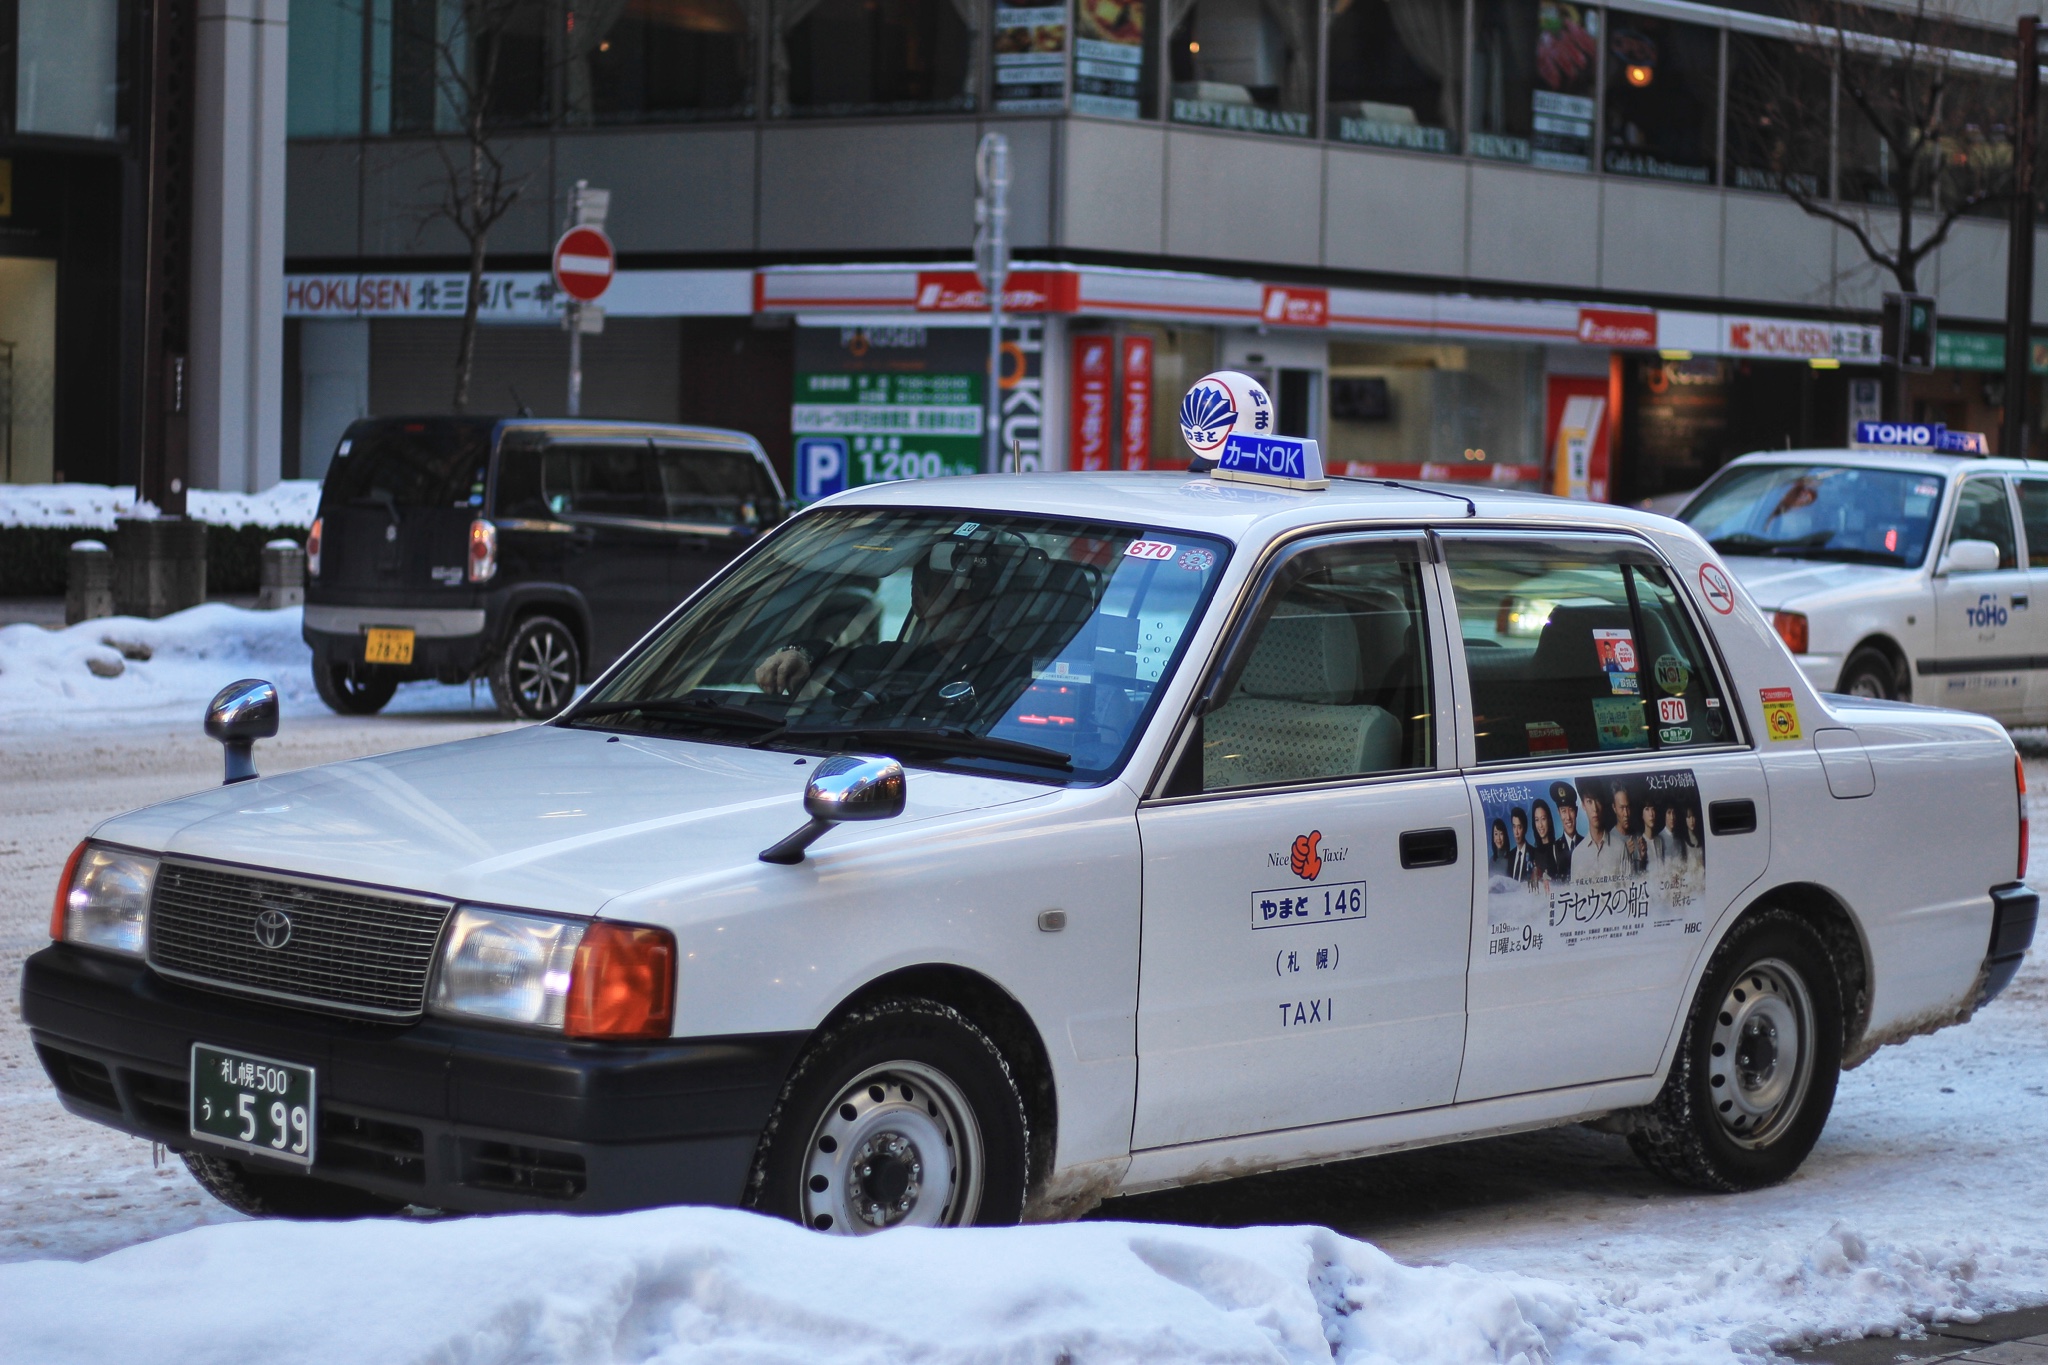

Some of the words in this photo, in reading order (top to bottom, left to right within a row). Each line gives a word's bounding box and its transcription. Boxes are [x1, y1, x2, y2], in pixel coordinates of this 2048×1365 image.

[287, 279, 410, 310] HOKUSEN
[1755, 325, 1830, 355] HOKUSEN
[1184, 430, 1218, 443] やまと
[1864, 424, 1930, 445] TOHO
[1225, 441, 1300, 475] カードOK
[808, 445, 839, 494] P
[1129, 541, 1172, 558] 670
[1967, 603, 2008, 627] TOHO
[1661, 700, 1685, 721] 670
[1646, 772, 1695, 791] 父と子の奇跡
[1480, 786, 1534, 804] 時代を超えた
[1267, 853, 1290, 868] Nice
[1322, 847, 1349, 863] Taxi!
[1260, 897, 1308, 920] やまと
[1324, 888, 1361, 916] 146
[1555, 881, 1650, 927] テセウスの船
[1684, 921, 1702, 934] HBC
[1279, 998, 1332, 1027] TAXI
